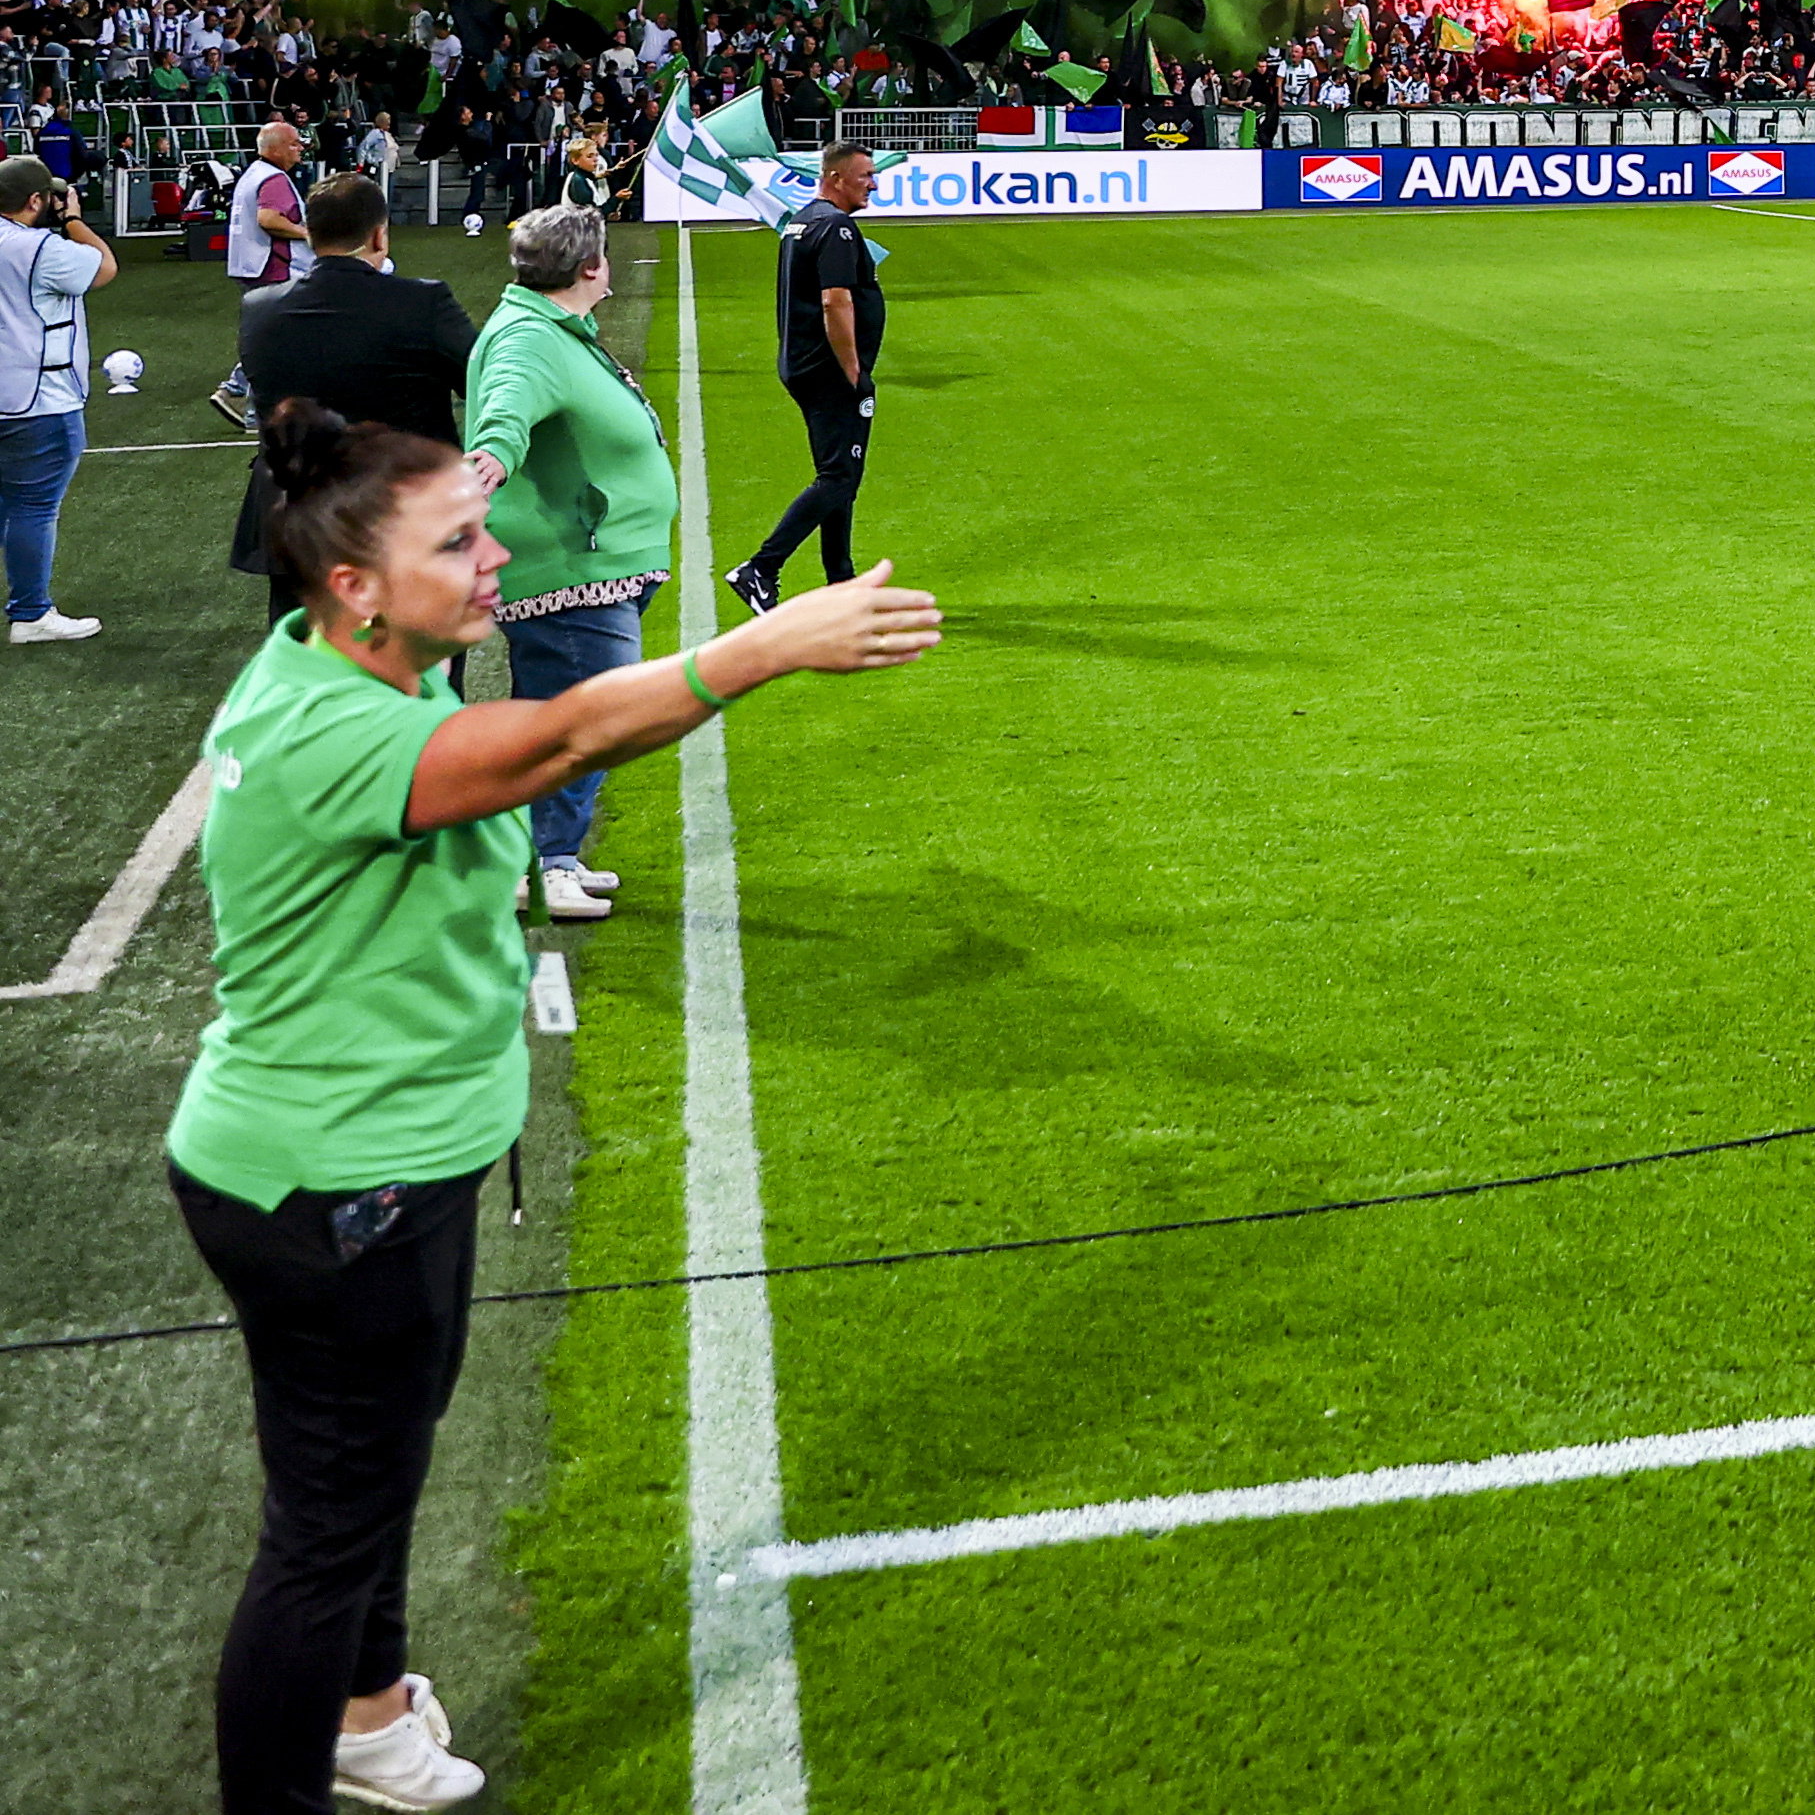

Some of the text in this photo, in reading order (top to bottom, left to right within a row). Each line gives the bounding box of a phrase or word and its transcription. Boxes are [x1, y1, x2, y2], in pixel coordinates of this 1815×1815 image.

[872, 159, 1148, 207] utokan.nl
[1315, 173, 1369, 184] AMASUS
[1400, 153, 1693, 199] AMASUS.nl
[1722, 168, 1772, 179] AMASUS
